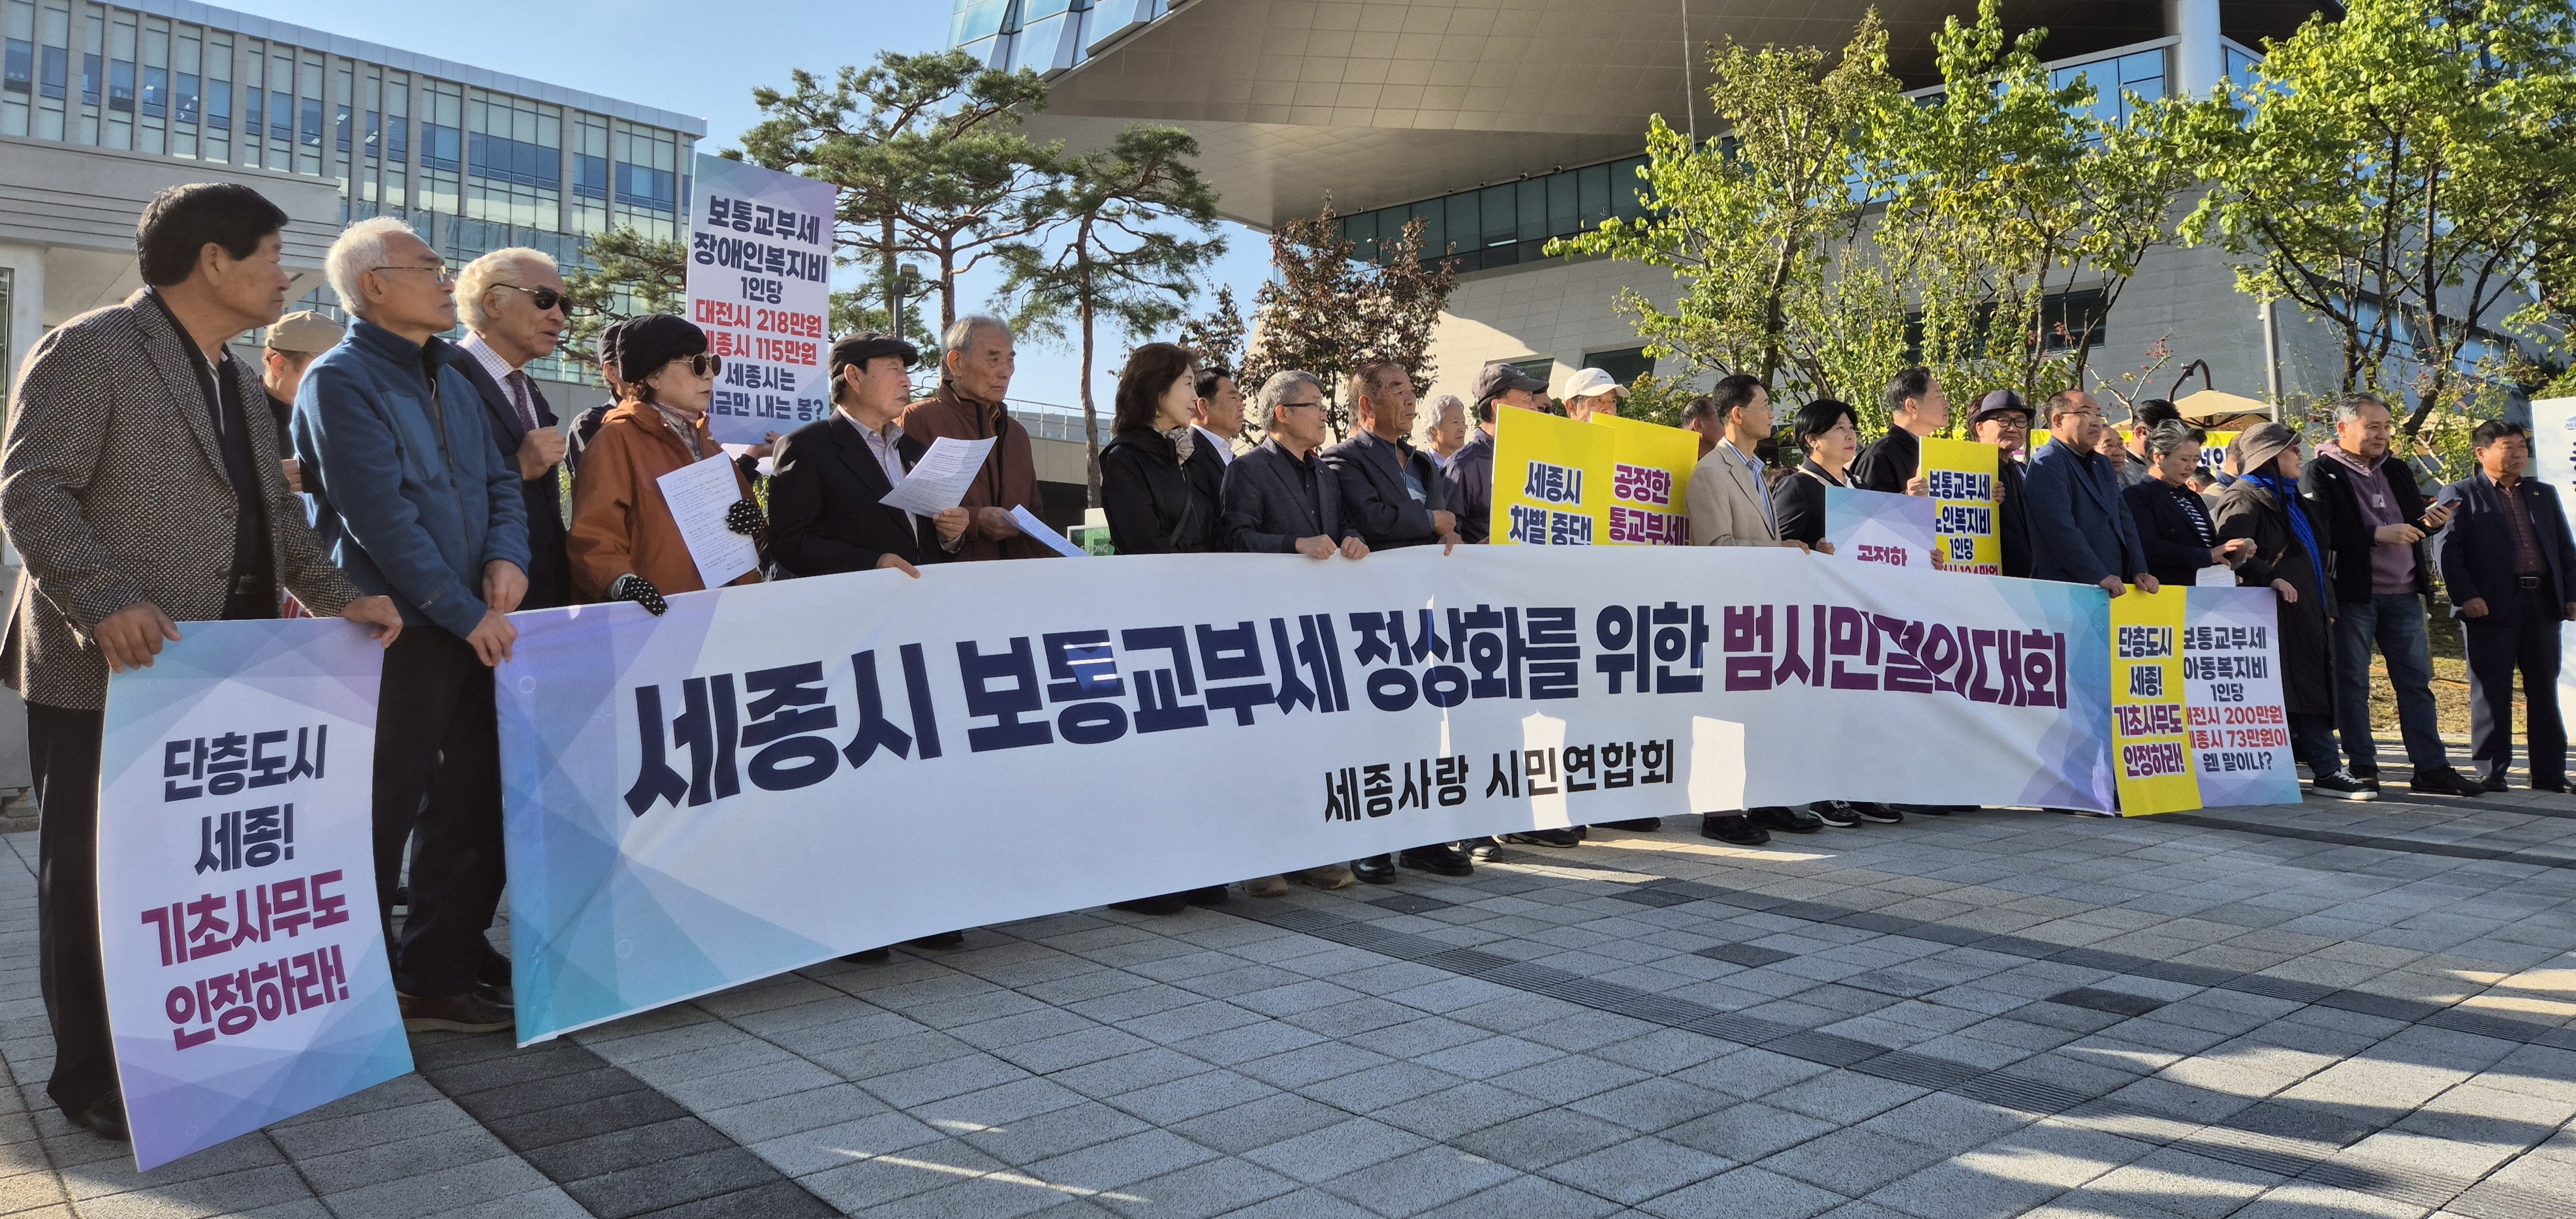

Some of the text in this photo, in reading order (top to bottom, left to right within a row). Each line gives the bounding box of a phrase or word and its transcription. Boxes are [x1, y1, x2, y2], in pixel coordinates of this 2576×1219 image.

[708, 195, 821, 245] 보통교부세
[693, 232, 827, 283] 장애인복지비
[741, 277, 783, 305] 1인당
[695, 298, 822, 339] 대전시 218만원
[756, 337, 817, 366] 115만원
[725, 362, 795, 392] 세종시는
[757, 395, 791, 420] 내는
[796, 398, 823, 422] 봉?
[1525, 461, 1582, 504] 세종시
[1614, 464, 1671, 504] 공정한
[1929, 470, 1990, 501] 보통교부세
[1509, 504, 1592, 545] 차별 중단!
[1949, 537, 1974, 561] 1인당
[2118, 626, 2172, 658] 단층도시
[2184, 626, 2267, 650] 보통교부세
[2129, 666, 2163, 696] 세종!
[2184, 656, 2269, 680] 아동복지비
[2210, 683, 2244, 702] 1인당
[624, 601, 2067, 818] 세종시 보통교부세 정상화를 위한 범시민결의대회
[2114, 704, 2184, 736] 기초사무도
[2224, 705, 2284, 724] 200만원
[2226, 728, 2288, 748] 73만원이
[163, 725, 328, 804] 단층도시
[2123, 743, 2186, 777] 인정하라!
[2203, 751, 2272, 772] 웬 말이냐?
[1325, 739, 1674, 823] 세종사랑 시민연합회
[195, 803, 294, 876] 세종!
[141, 869, 349, 967] 기초사무도
[165, 944, 351, 1051] 인정하라!
